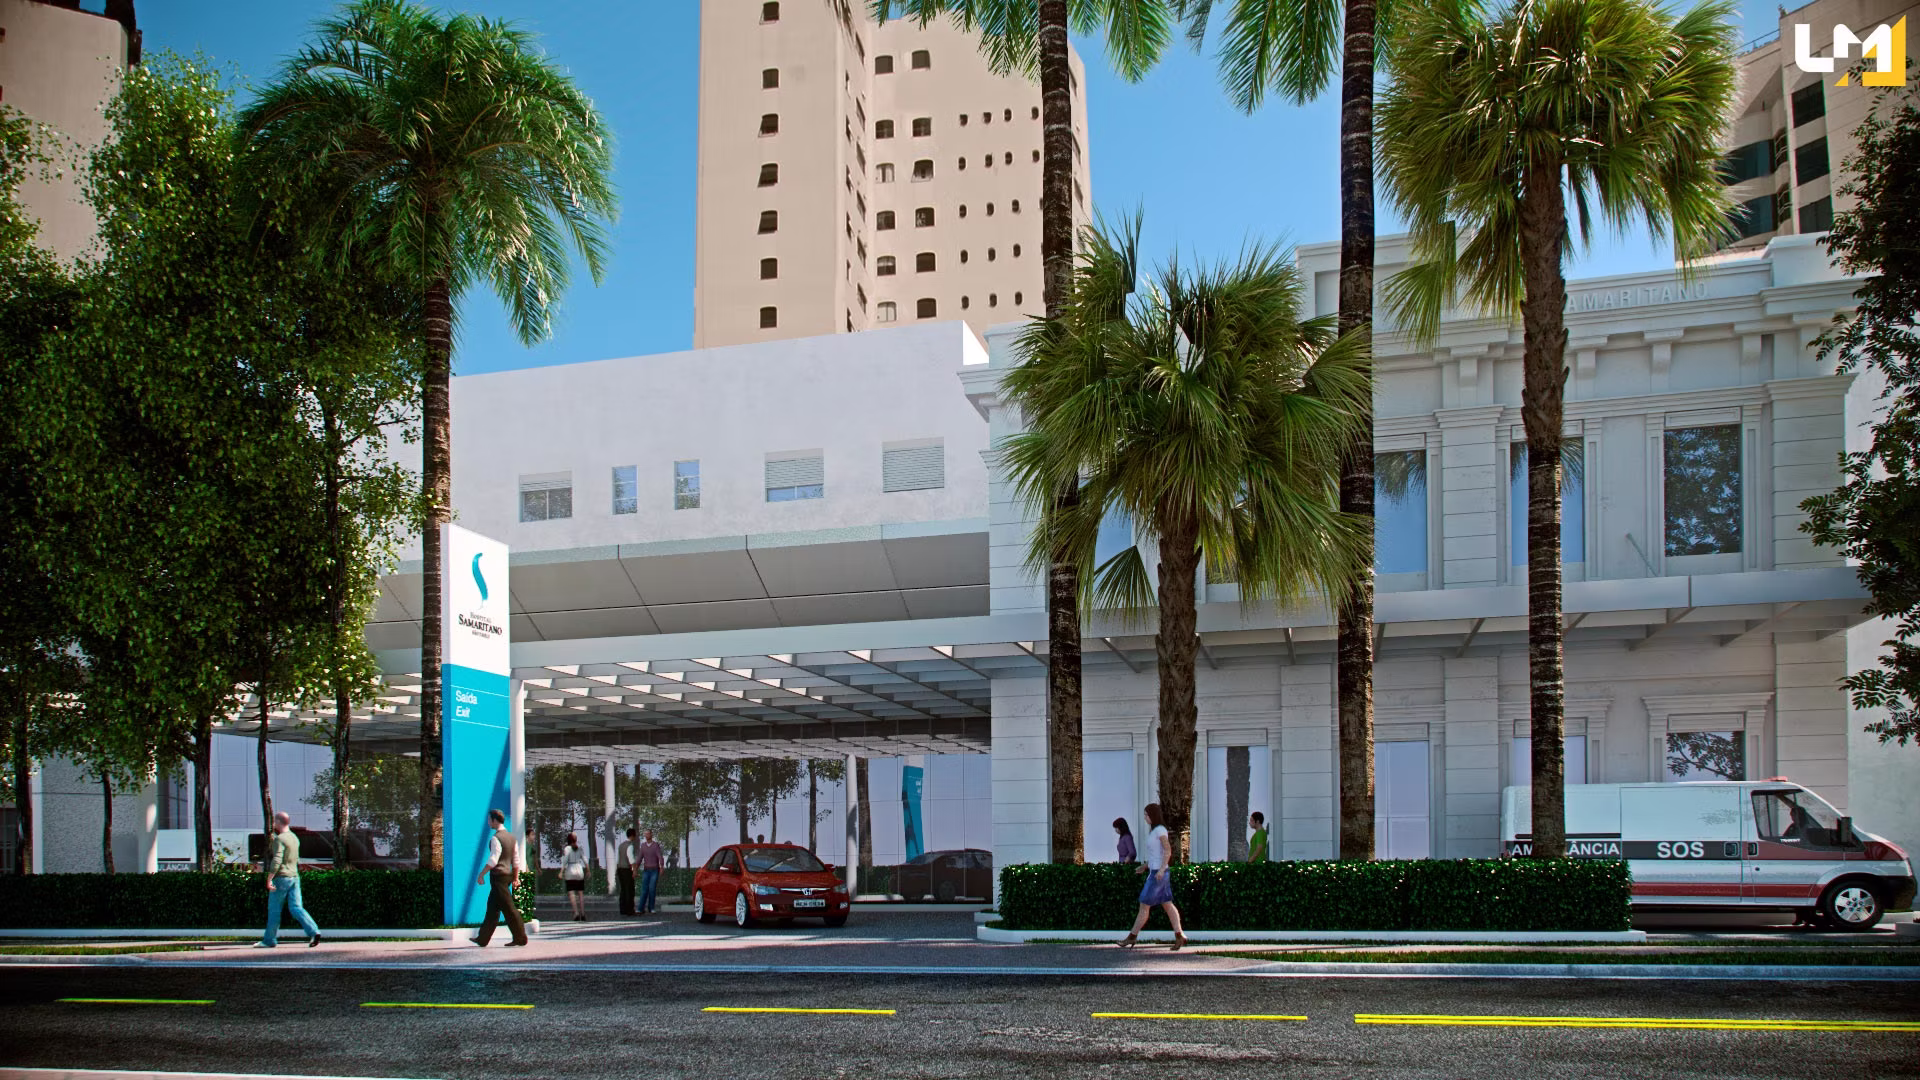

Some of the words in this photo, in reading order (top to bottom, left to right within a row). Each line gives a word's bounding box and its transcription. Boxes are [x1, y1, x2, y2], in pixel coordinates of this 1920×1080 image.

[1565, 282, 1708, 313] AMARITANO
[459, 614, 502, 635] SAMARITANO
[456, 690, 478, 704] Saída
[456, 706, 470, 718] Exit
[1512, 841, 1619, 856] AMÂNCIA
[1657, 842, 1704, 858] SOS
